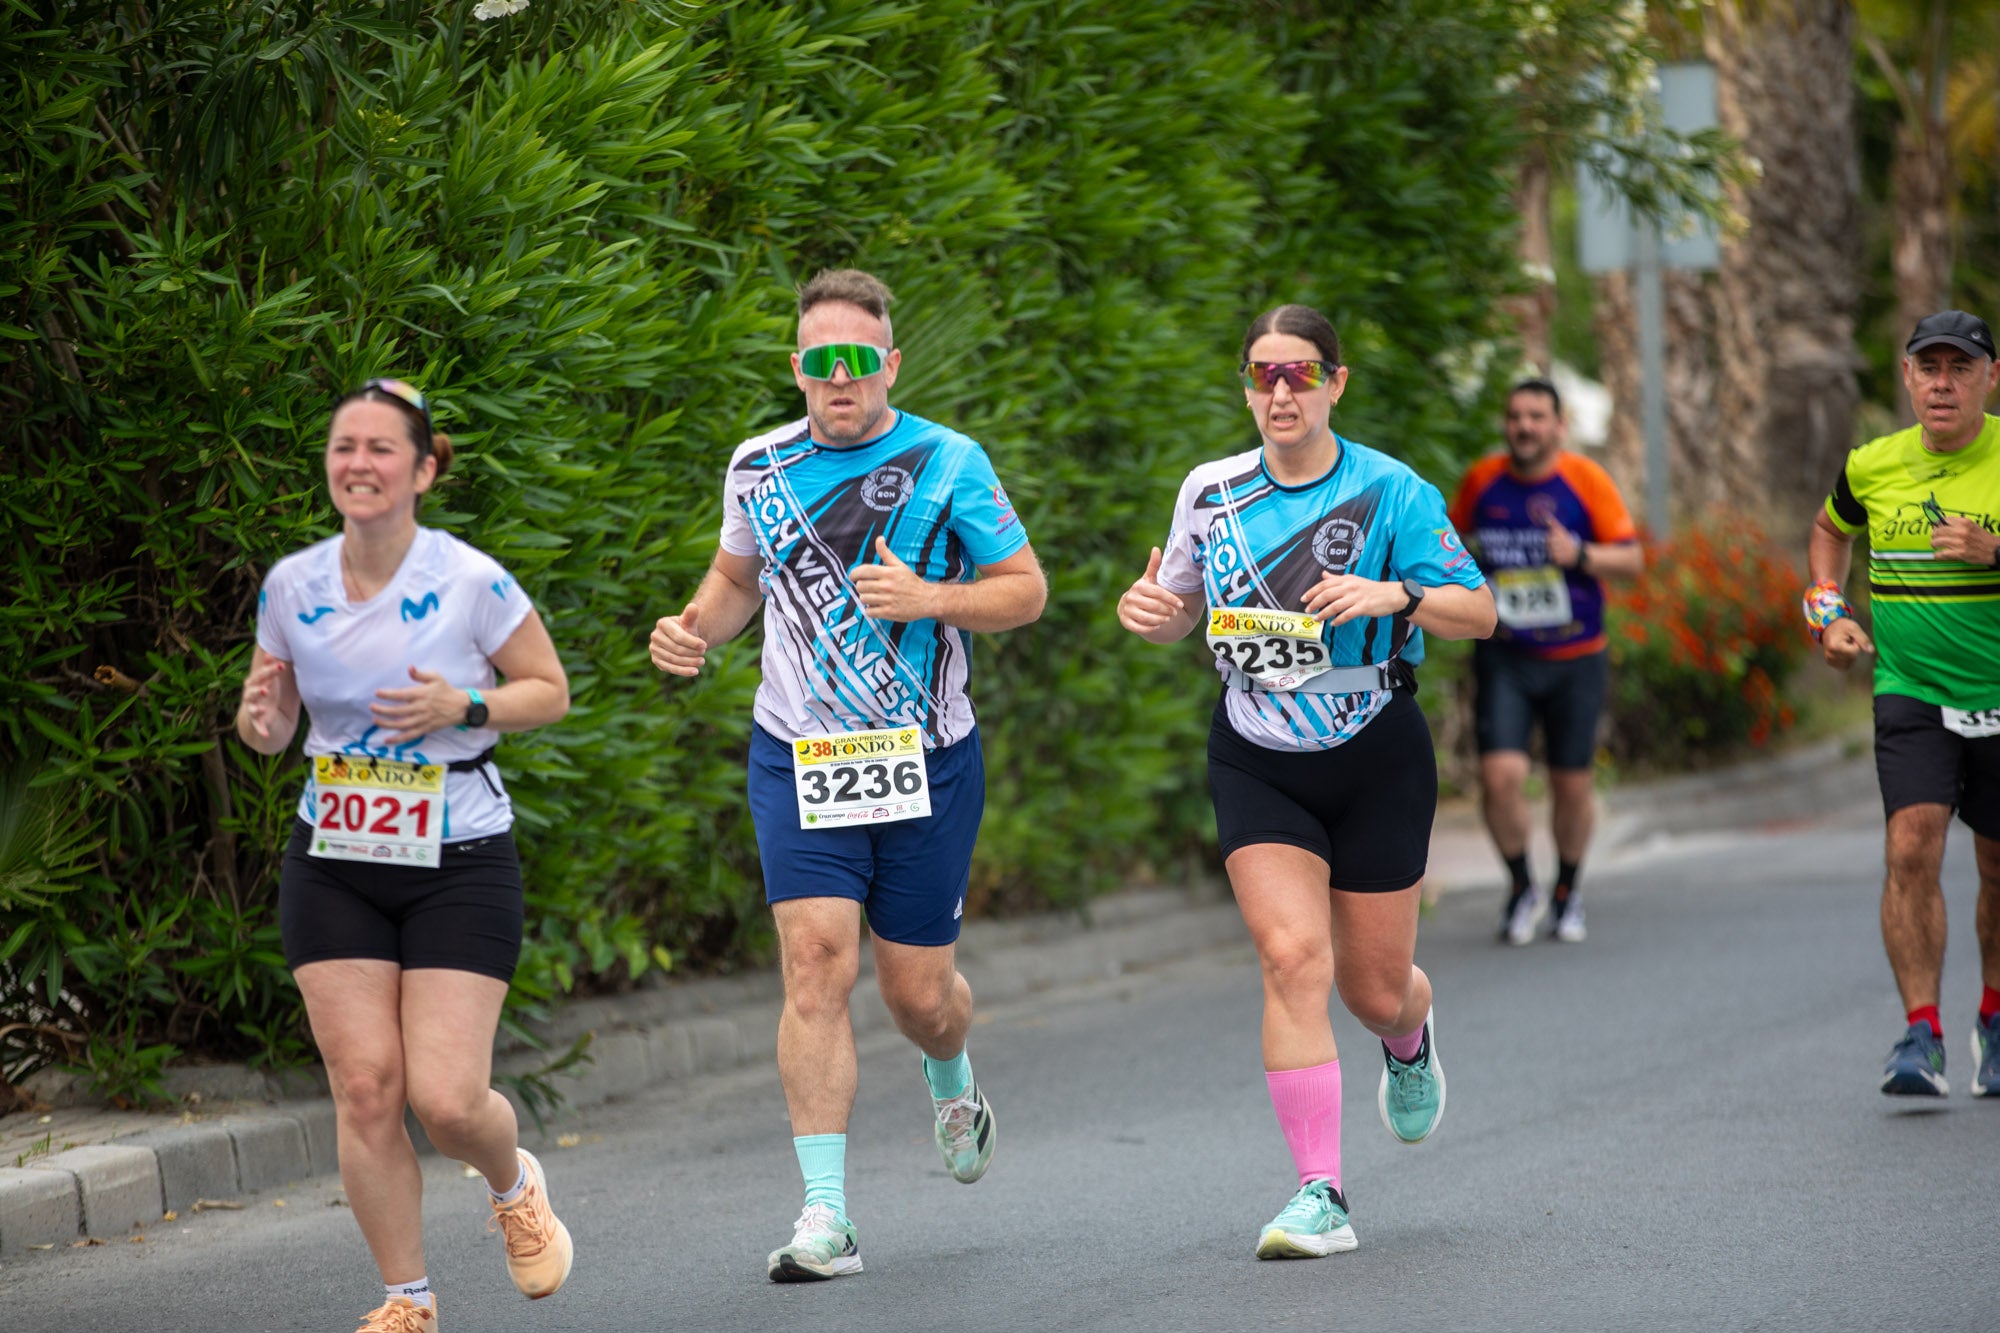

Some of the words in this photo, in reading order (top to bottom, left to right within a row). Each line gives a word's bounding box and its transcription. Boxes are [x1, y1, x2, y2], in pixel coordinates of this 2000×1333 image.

[1210, 518, 1252, 602] ECH
[754, 476, 800, 551] ECH
[795, 546, 928, 723] WELLNESS
[1221, 613, 1236, 630] 38
[1236, 619, 1295, 632] FONDO
[1260, 614, 1291, 622] PREMIO
[1213, 637, 1324, 674] 3235
[812, 741, 833, 758] 38
[832, 740, 895, 757] FONDO
[835, 737, 858, 745] GRAN
[859, 734, 888, 742] PREMIO
[347, 766, 415, 786] FONDO
[801, 760, 923, 804] 3236
[319, 791, 430, 838] 2021
